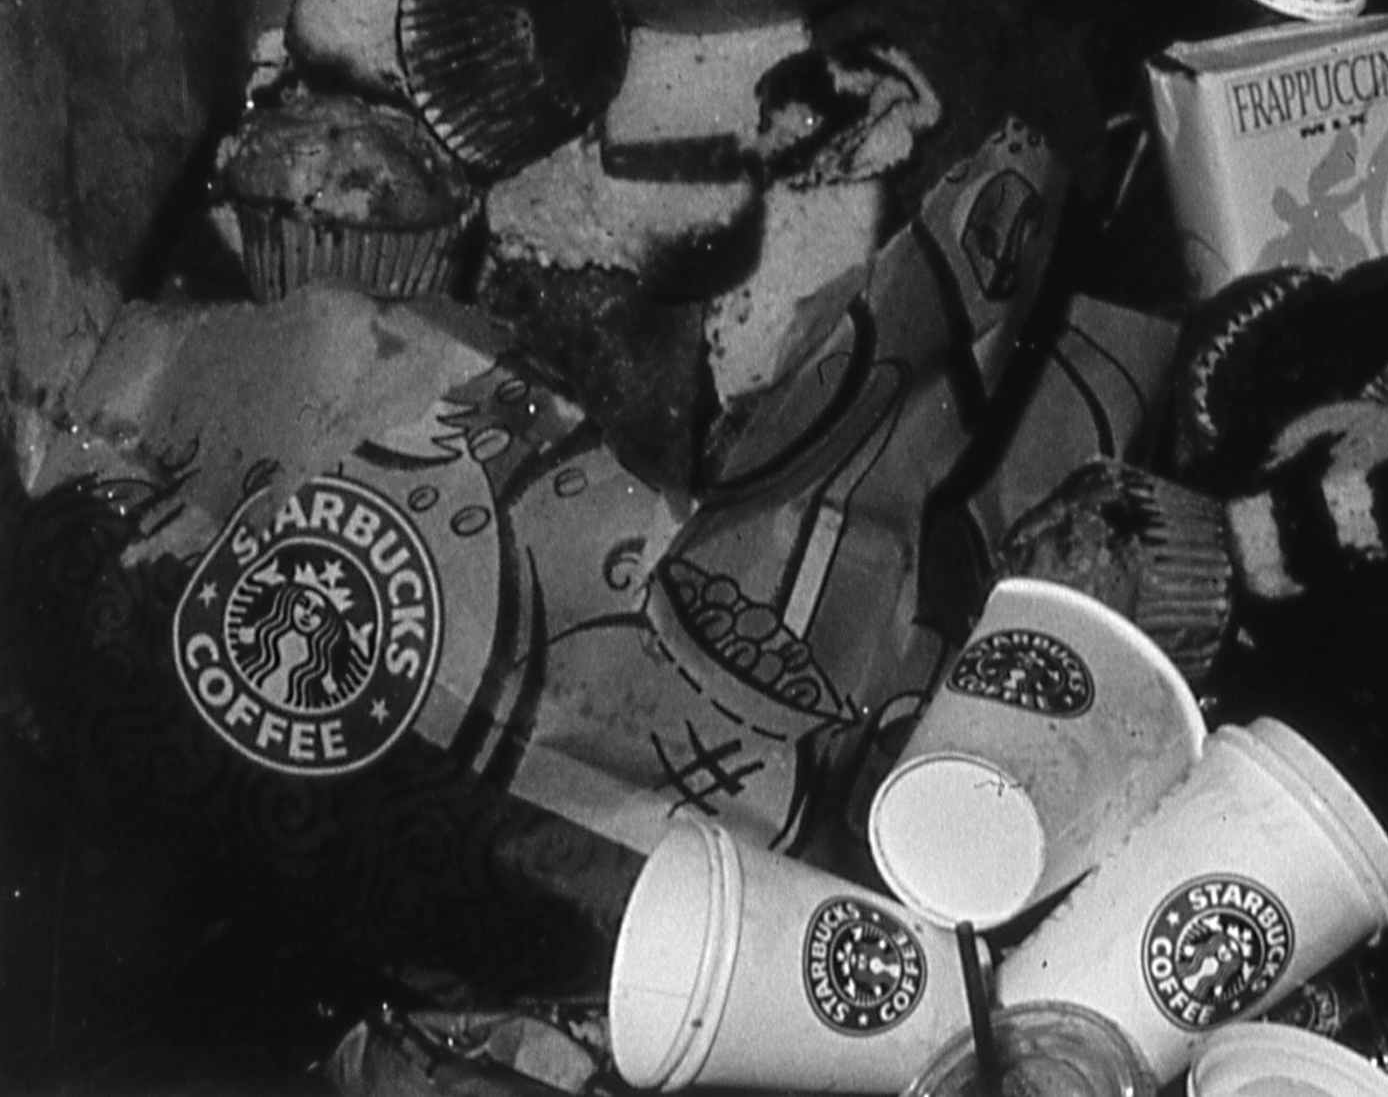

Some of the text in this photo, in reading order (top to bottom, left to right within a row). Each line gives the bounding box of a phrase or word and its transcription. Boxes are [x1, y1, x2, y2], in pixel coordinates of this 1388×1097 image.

[231, 490, 426, 680] SARBUCKS
[185, 633, 347, 760] COFFEE
[810, 903, 860, 1022] STARBUCKS
[880, 932, 919, 1022] COFFEE
[1151, 936, 1215, 1025] COFFEE
[1188, 882, 1286, 992] STARBUCKS
